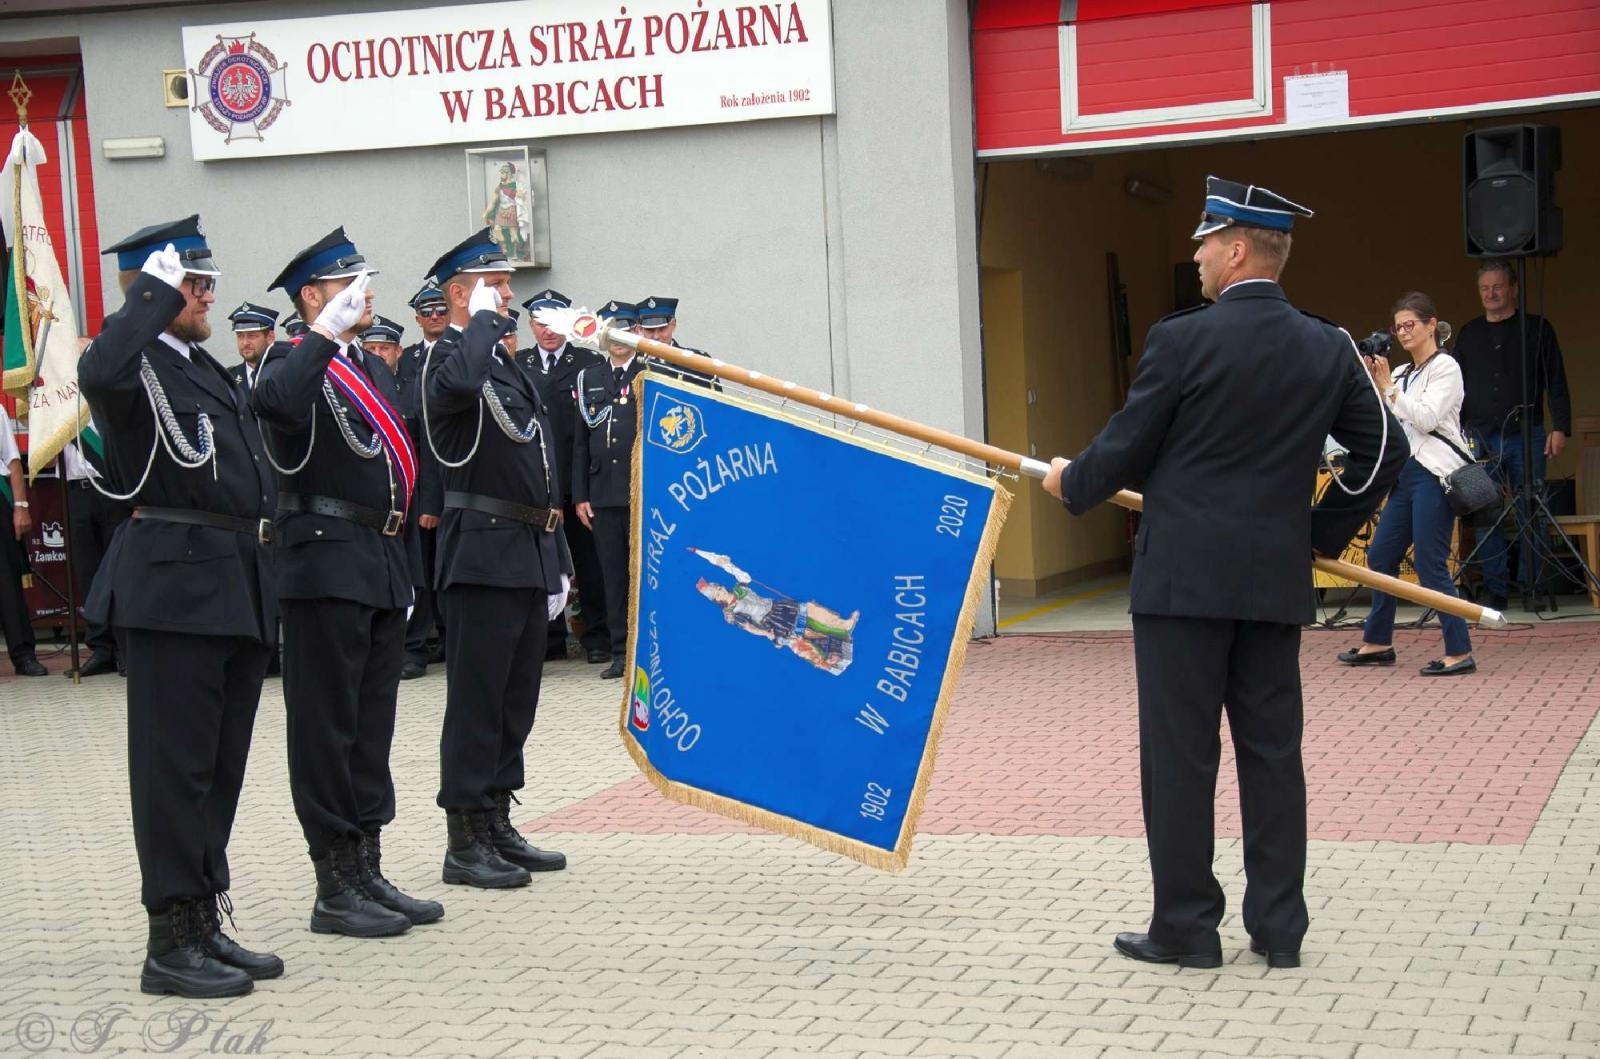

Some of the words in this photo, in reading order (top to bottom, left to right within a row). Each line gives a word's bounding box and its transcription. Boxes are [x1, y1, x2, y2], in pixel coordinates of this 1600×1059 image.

[307, 27, 521, 84] OCHOTNICZA
[529, 6, 635, 66] STRAŻ
[643, 0, 808, 56] POŻARNA
[440, 90, 474, 123] W
[485, 74, 664, 121] BABICACH
[720, 94, 739, 109] Rok
[741, 91, 785, 107] założenia
[788, 88, 811, 102] 1902
[33, 393, 51, 409] ZA
[667, 441, 779, 512] POŻARNA
[935, 494, 969, 539] 2020
[647, 507, 677, 591] STRAŻ
[649, 611, 702, 752] OCHOTNICZA
[855, 703, 890, 735] W
[876, 574, 927, 703] BABICACH
[859, 782, 893, 822] 1902
